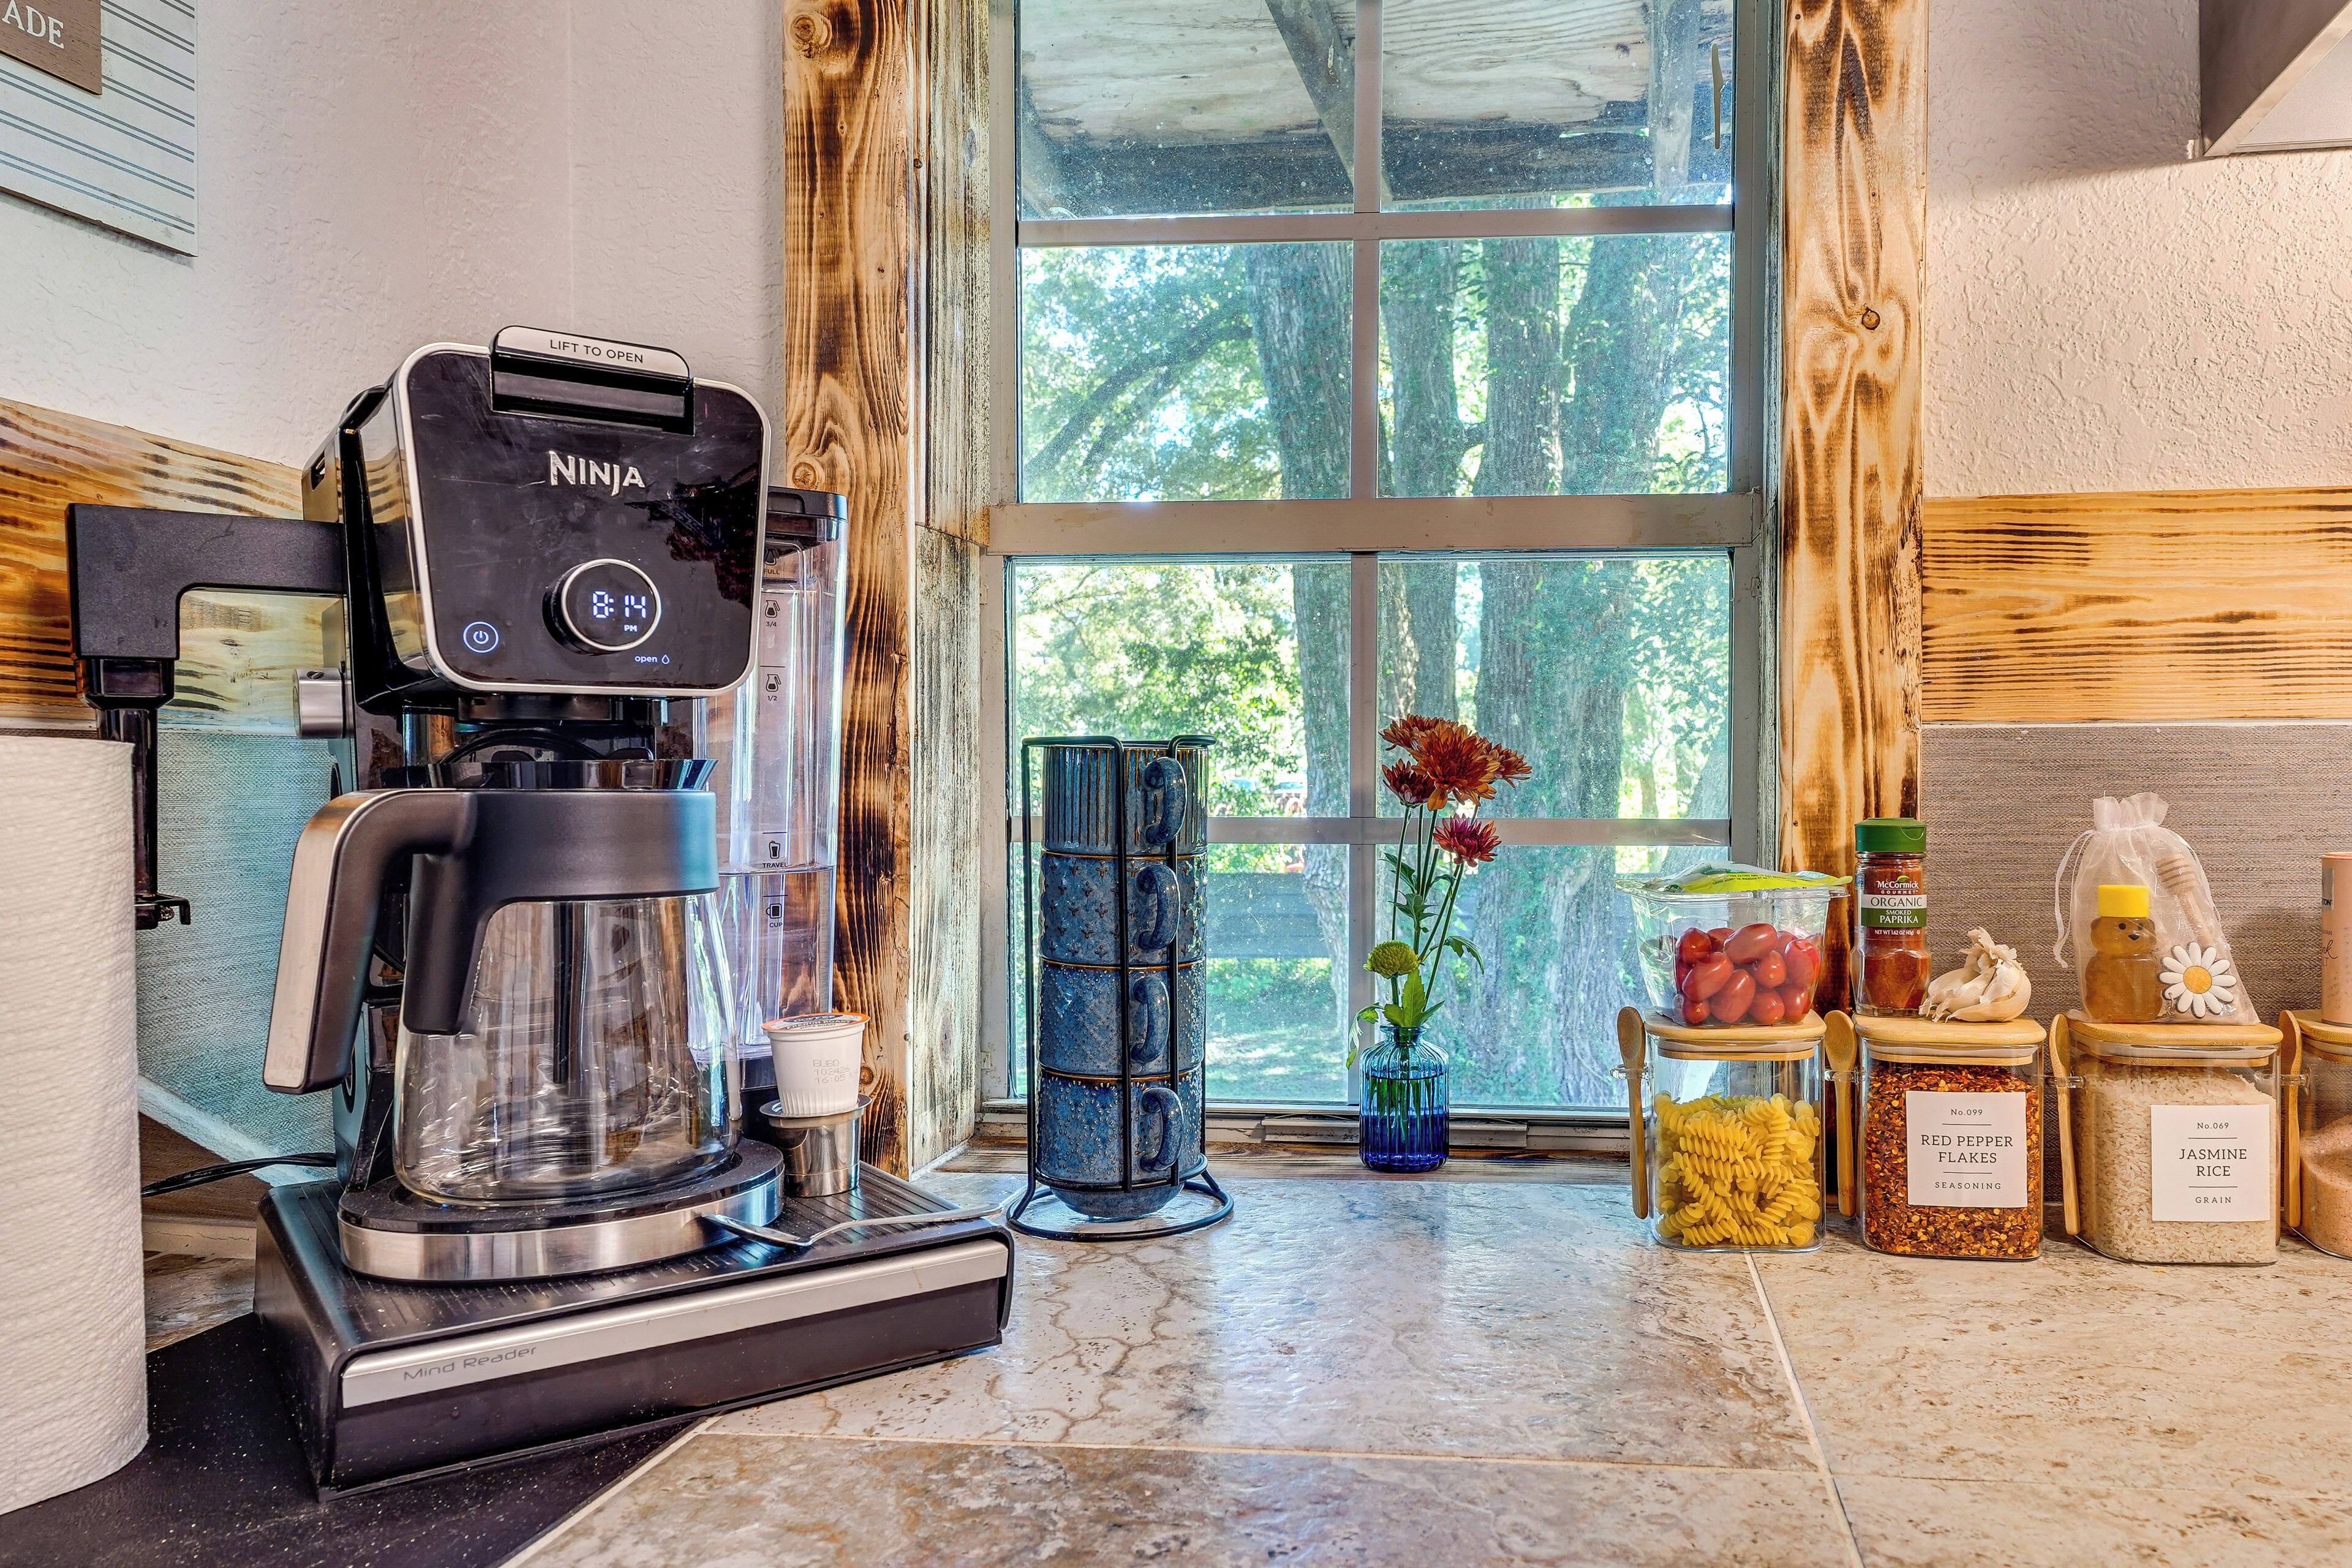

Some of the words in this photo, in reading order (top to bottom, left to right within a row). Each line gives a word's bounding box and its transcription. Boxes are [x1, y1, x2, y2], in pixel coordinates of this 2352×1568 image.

[550, 339, 579, 353] LIFT
[583, 345, 601, 356] TO
[606, 349, 643, 364] OPEN
[548, 450, 645, 497] NINJA
[592, 590, 647, 619] 8:14
[635, 655, 657, 663] open
[1876, 880, 1919, 889] McCormick
[1871, 897, 1922, 907] ORGANIC
[1880, 915, 1918, 924] PAPRIKA
[1921, 1134, 1952, 1146] RED
[1957, 1136, 2013, 1147] PEPPER
[1938, 1152, 1997, 1164] FLAKES
[2179, 1149, 2247, 1160] JASMINE
[2196, 1166, 2231, 1177] RICE
[1935, 1182, 2001, 1190] SEASONING
[404, 1362, 455, 1381] Mind
[463, 1348, 537, 1369] Reader
